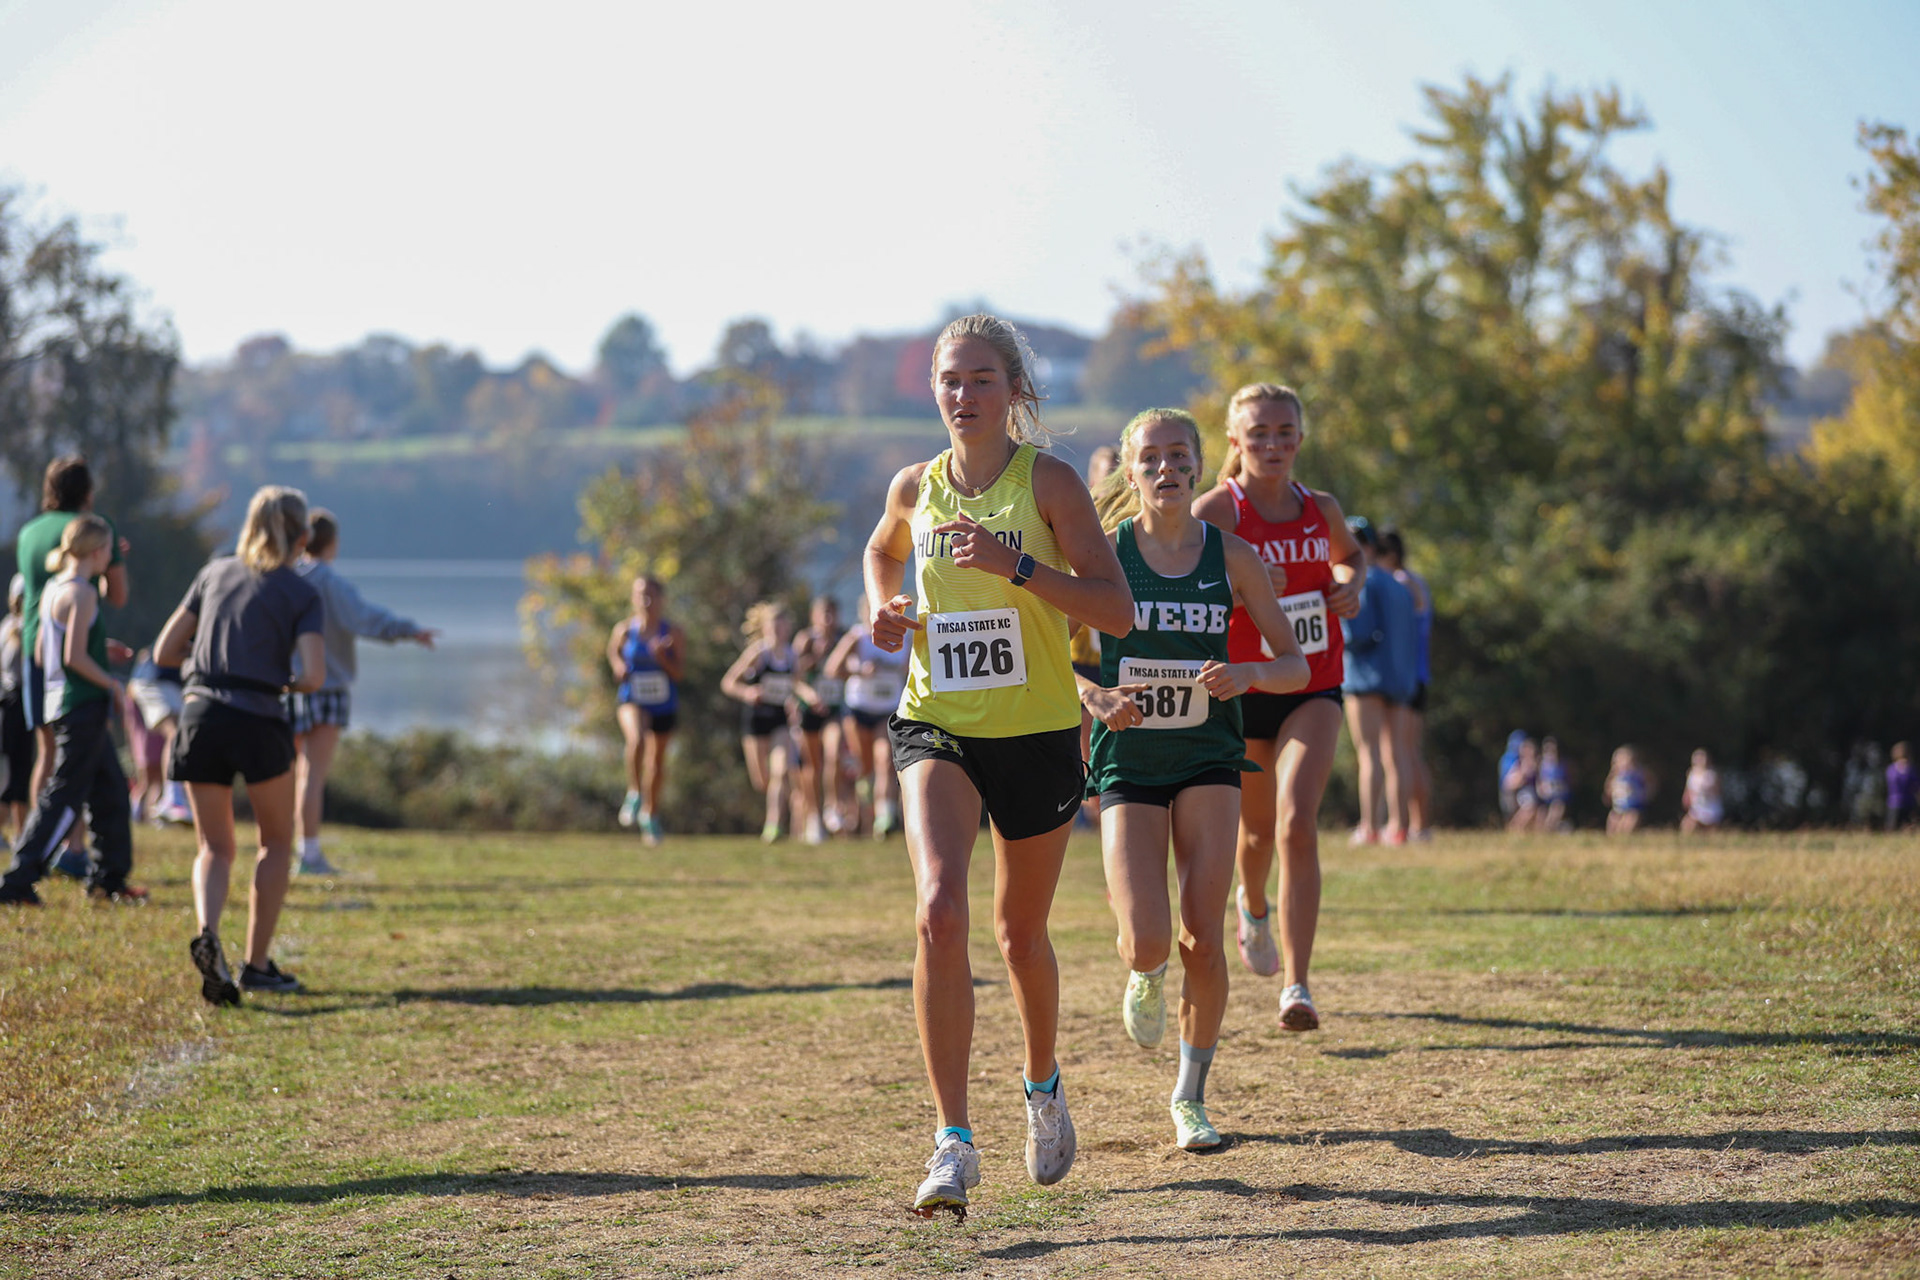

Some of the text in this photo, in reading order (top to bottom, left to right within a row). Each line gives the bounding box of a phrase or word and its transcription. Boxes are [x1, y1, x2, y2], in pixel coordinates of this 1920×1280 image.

[1251, 537, 1330, 564] AYLOR
[936, 618, 1011, 634] TMSAA STATE XC
[1295, 615, 1323, 645] 06
[937, 637, 1014, 679] 1126
[1128, 666, 1160, 678] TMSAA
[1161, 668, 1187, 679] STATE
[1135, 685, 1193, 718] 587
